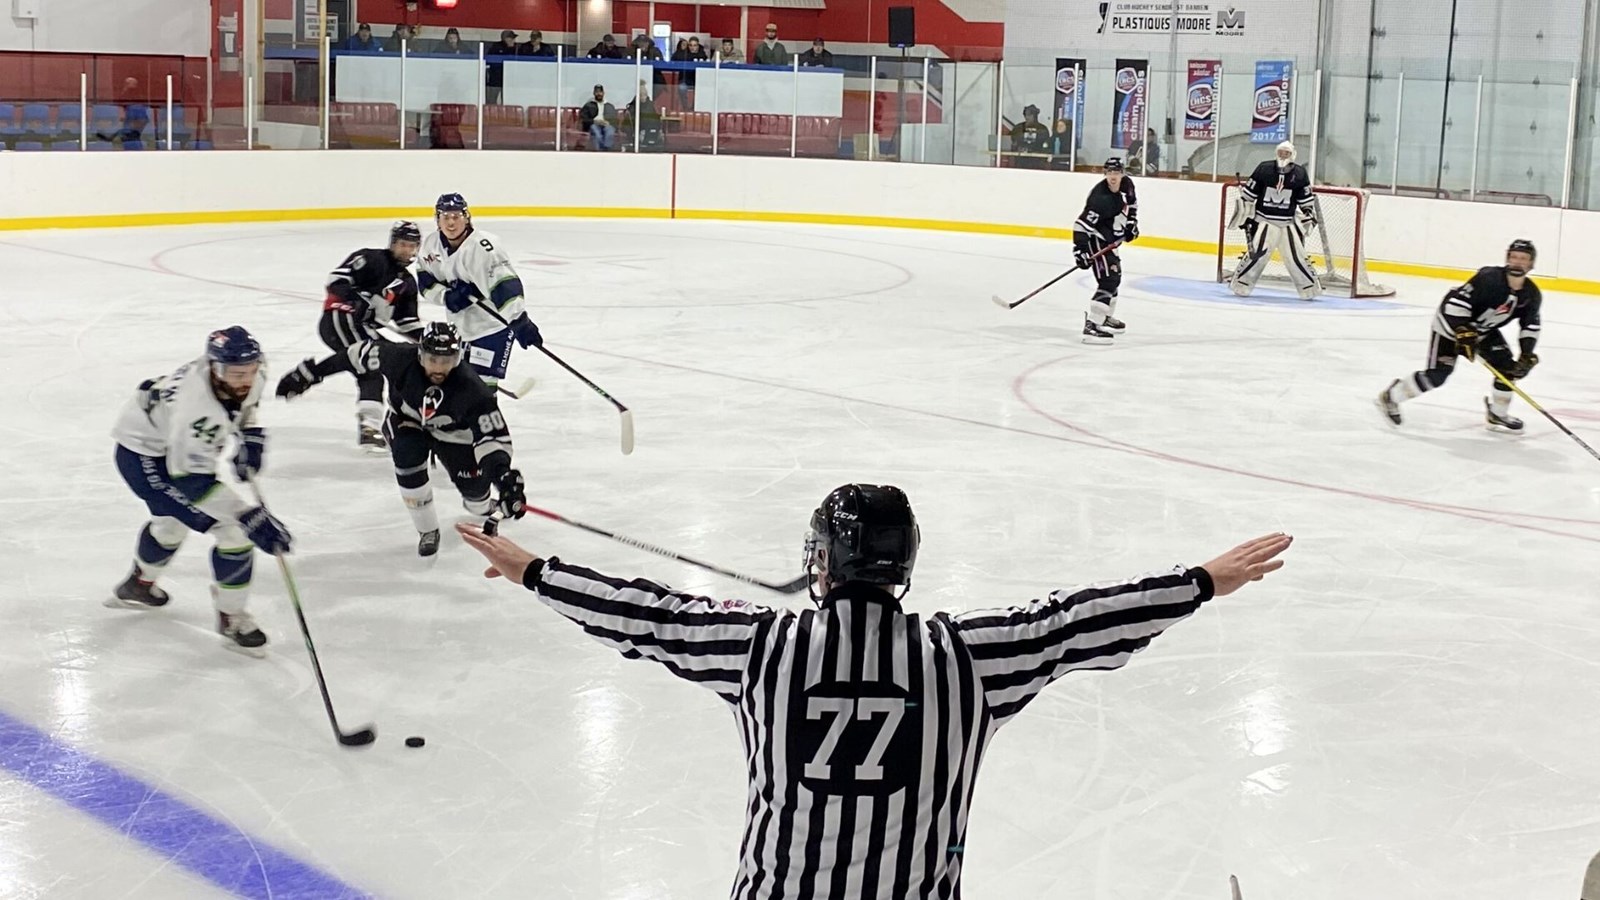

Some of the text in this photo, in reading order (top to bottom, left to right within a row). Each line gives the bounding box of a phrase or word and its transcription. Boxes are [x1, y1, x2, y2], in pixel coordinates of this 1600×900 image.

[1112, 17, 1211, 30] PLASTIQUES MOORE
[1130, 70, 1145, 141] champions
[1258, 97, 1280, 109] LHCS
[1276, 65, 1290, 140] champions
[1252, 132, 1275, 140] 2017
[1086, 210, 1100, 224] 27
[480, 238, 494, 252] 9
[477, 409, 505, 434] 80
[834, 511, 858, 521] CCM
[804, 697, 905, 780] 77
